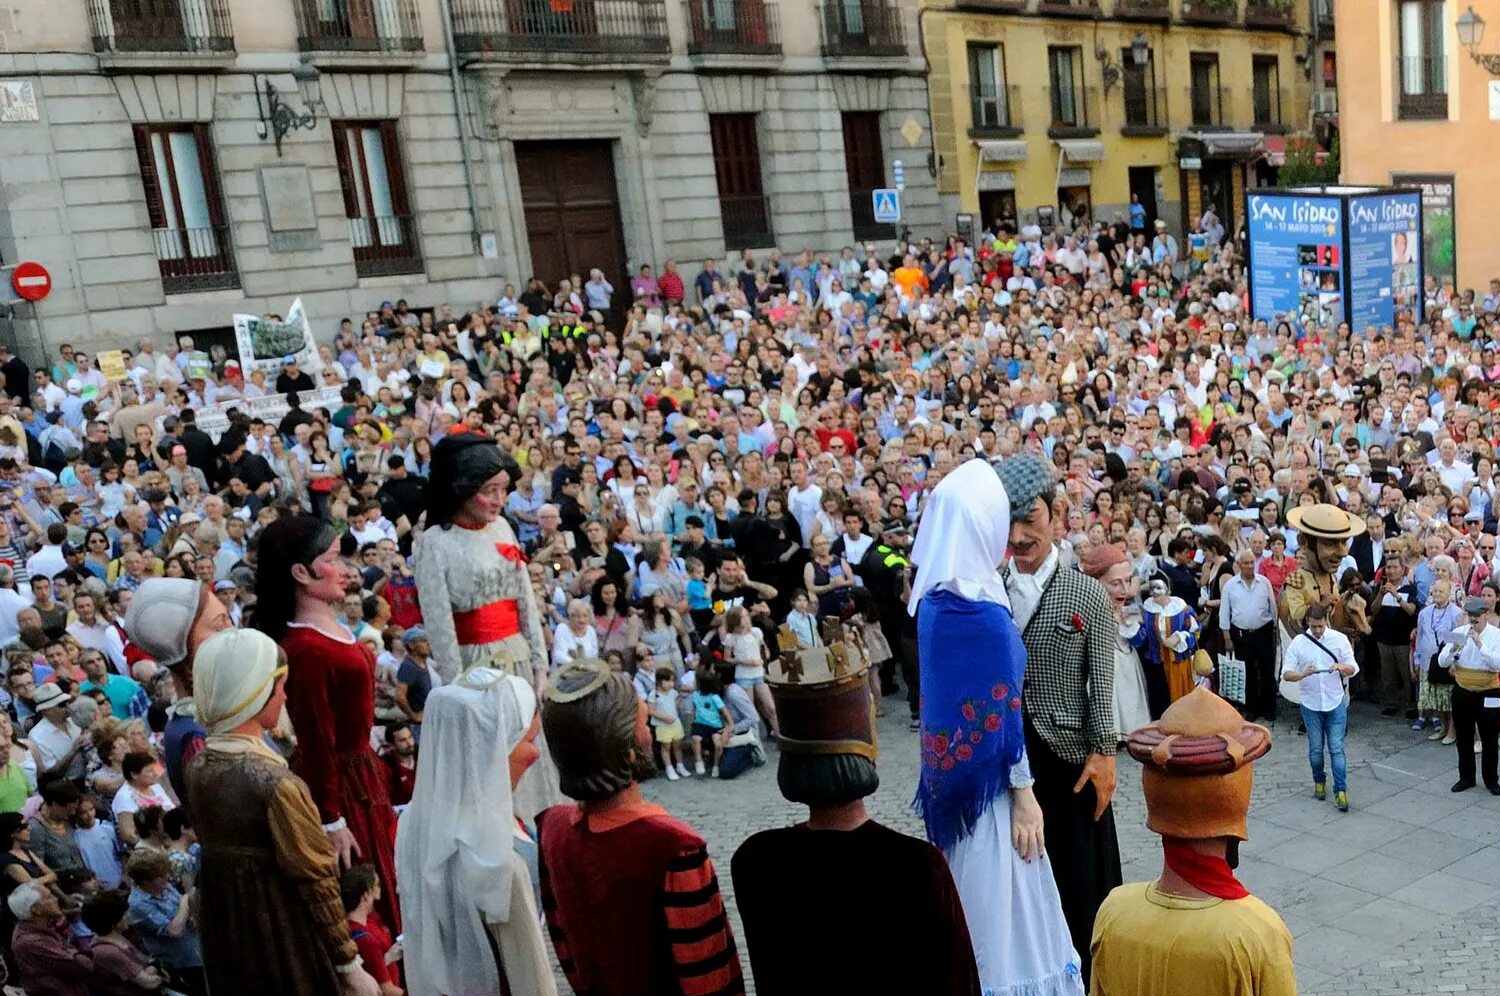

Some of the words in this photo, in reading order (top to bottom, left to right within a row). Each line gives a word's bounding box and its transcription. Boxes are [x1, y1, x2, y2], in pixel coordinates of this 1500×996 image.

[1252, 196, 1287, 220] SAN
[1350, 200, 1378, 224] SAN
[1287, 223, 1309, 233] MAYO
